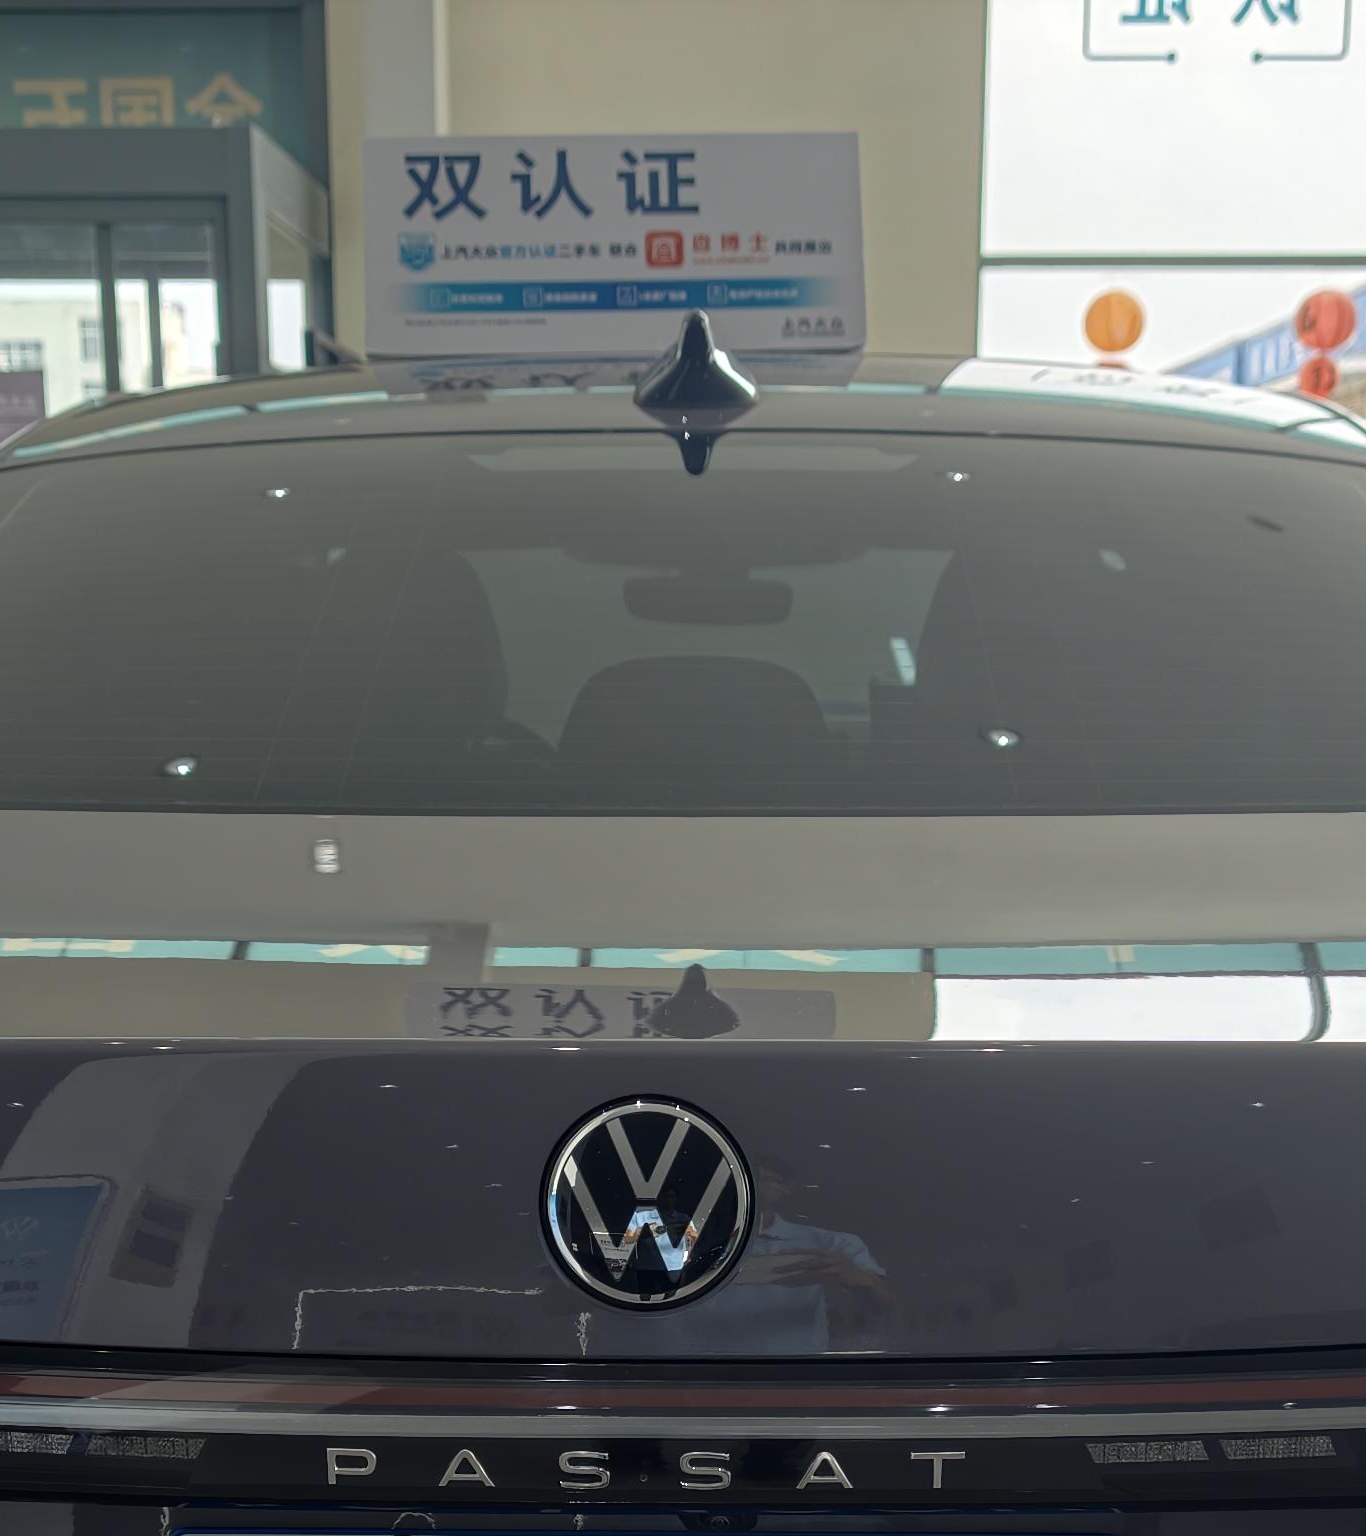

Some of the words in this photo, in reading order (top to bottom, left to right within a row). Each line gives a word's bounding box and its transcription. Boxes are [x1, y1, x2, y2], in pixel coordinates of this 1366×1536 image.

[403, 149, 700, 220] 双认证
[325, 1446, 966, 1490] PASSAT
